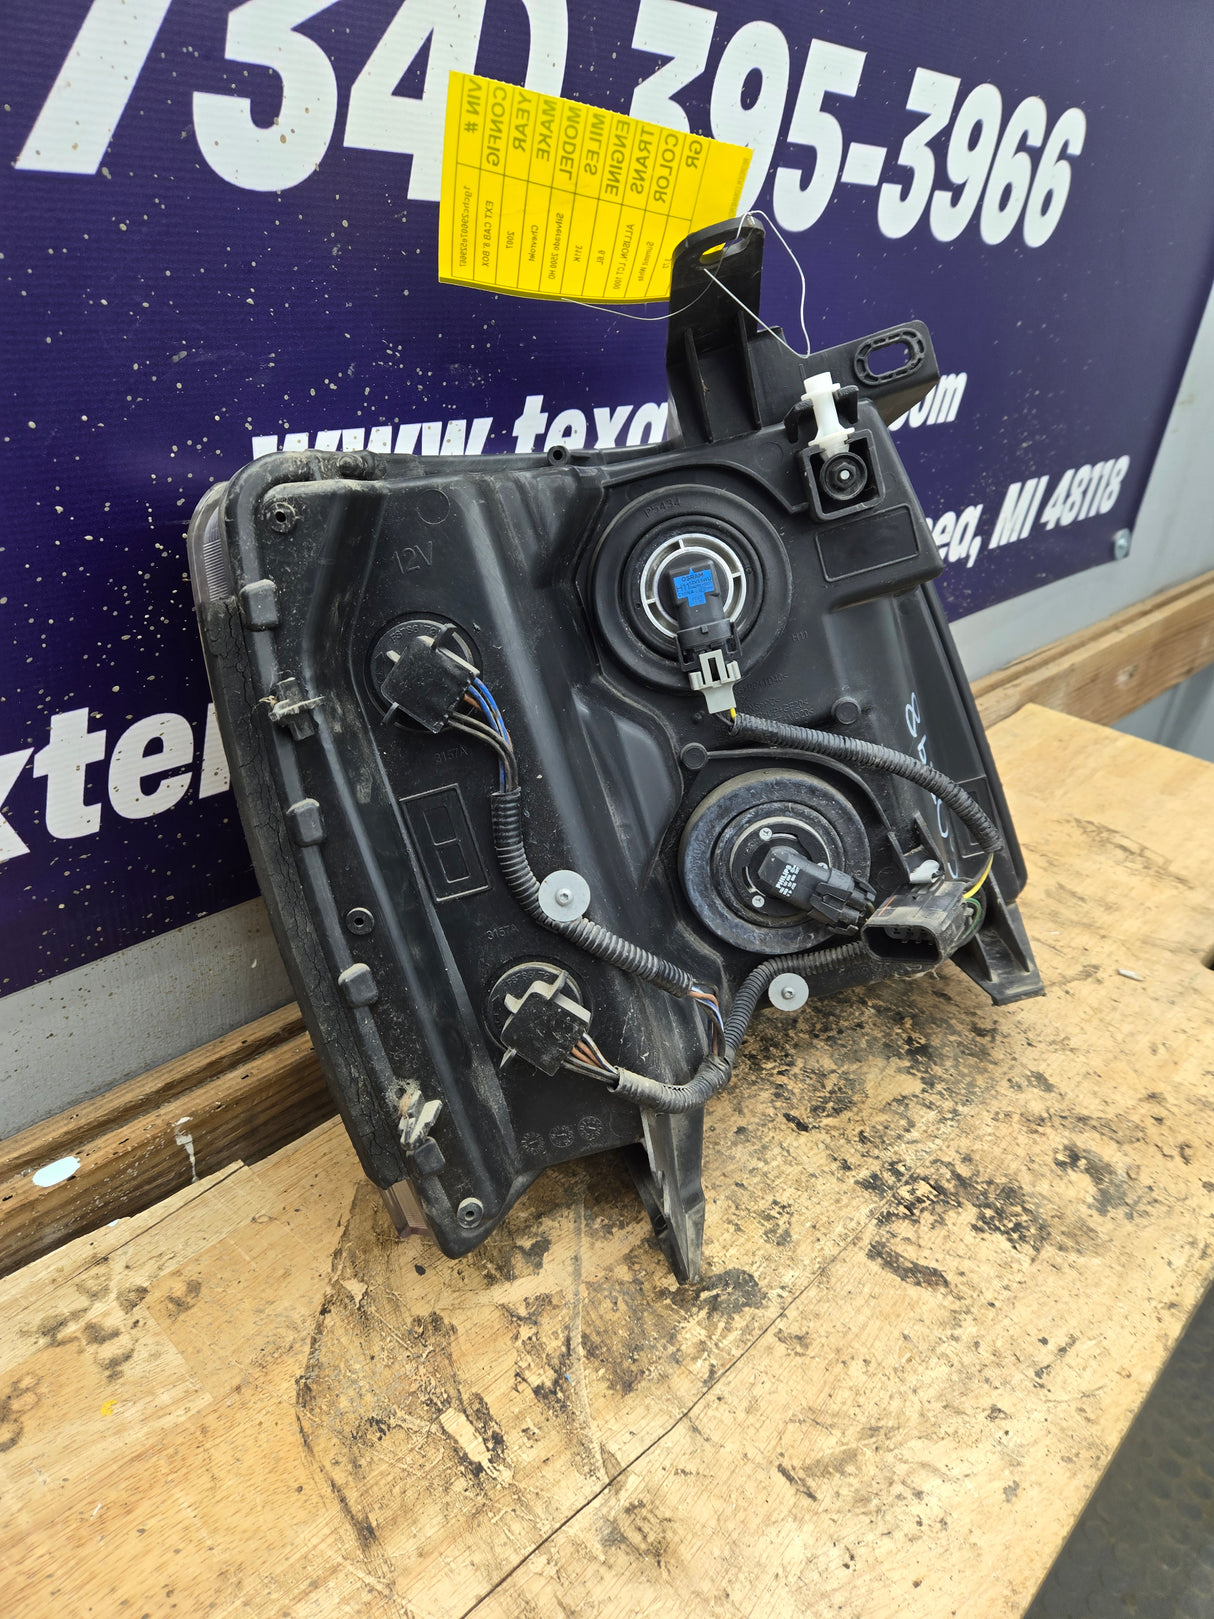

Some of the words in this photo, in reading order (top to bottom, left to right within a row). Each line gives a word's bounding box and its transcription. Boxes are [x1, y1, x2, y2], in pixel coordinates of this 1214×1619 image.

[988, 475, 1050, 549] MI
[1040, 455, 1131, 531] 48118
[393, 540, 433, 575] 12V
